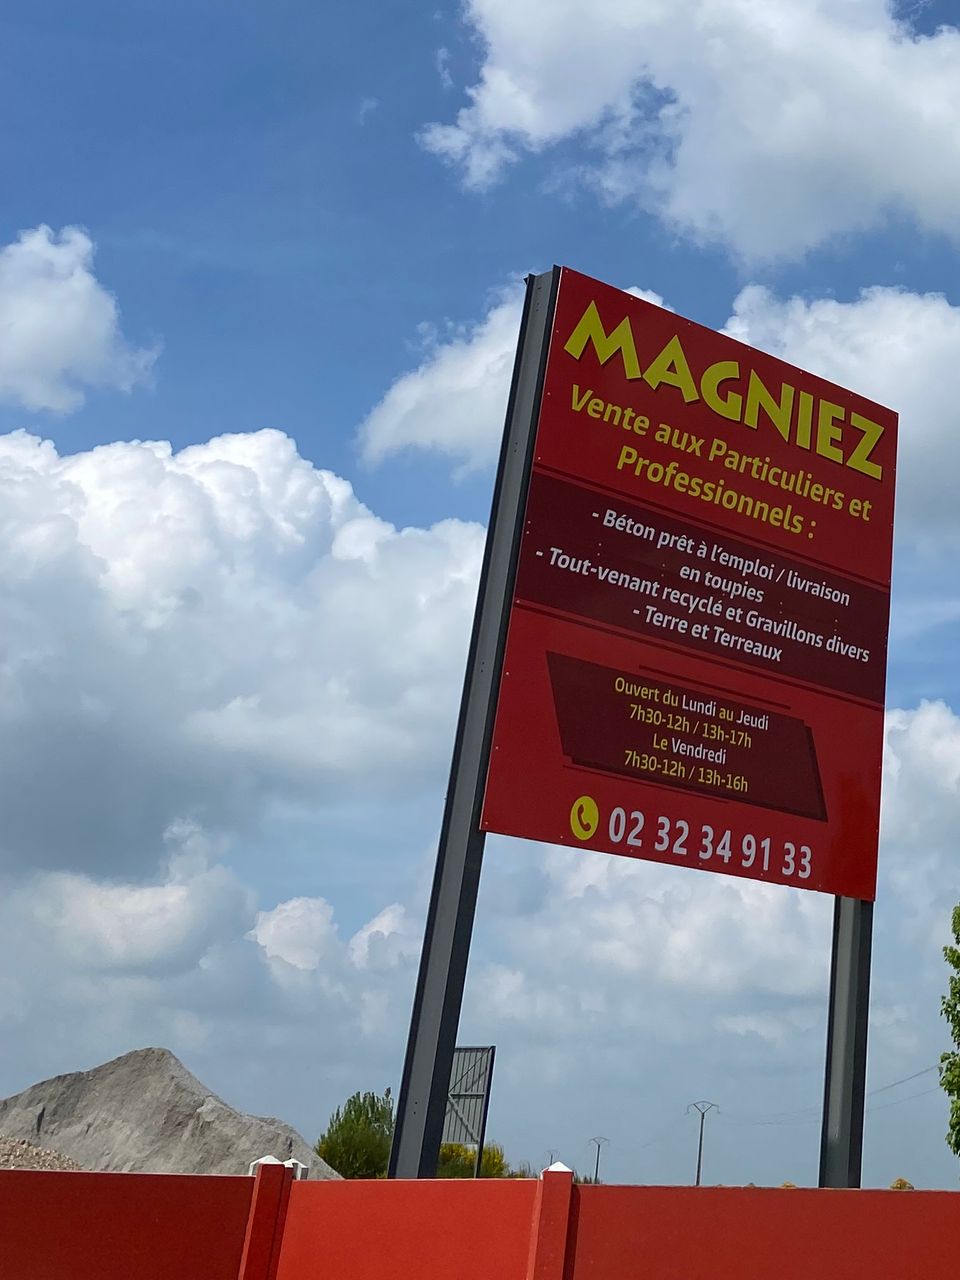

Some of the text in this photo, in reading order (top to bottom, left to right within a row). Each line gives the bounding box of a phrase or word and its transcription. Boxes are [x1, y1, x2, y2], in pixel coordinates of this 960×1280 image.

[564, 300, 885, 480] MAGNIEZ
[571, 384, 872, 521] Vente aux Particuliers et
[617, 446, 816, 539] Professionnels :
[603, 510, 656, 541] Béton
[658, 530, 694, 558] prêt
[697, 541, 707, 558] à
[711, 544, 774, 581] l'emploi
[776, 568, 785, 582] /
[787, 570, 850, 606] livraison
[680, 563, 764, 603] en toupies
[549, 548, 659, 596] Tout-venant
[662, 585, 722, 616] recyclé
[726, 604, 742, 622] et
[746, 610, 823, 648] Gravillons
[826, 634, 870, 662] divers
[645, 605, 687, 636] Terre
[691, 622, 709, 640] et
[713, 630, 782, 661] Terreaux
[615, 677, 769, 731] Ouvert du Lundi au Jeudi
[629, 704, 751, 748] 7h30-12h / 13h-17h
[624, 750, 749, 792] 7h30-12h / 13h-16h
[653, 734, 726, 764] Le Vendredi
[608, 807, 811, 879] 02 32 34 91 33
